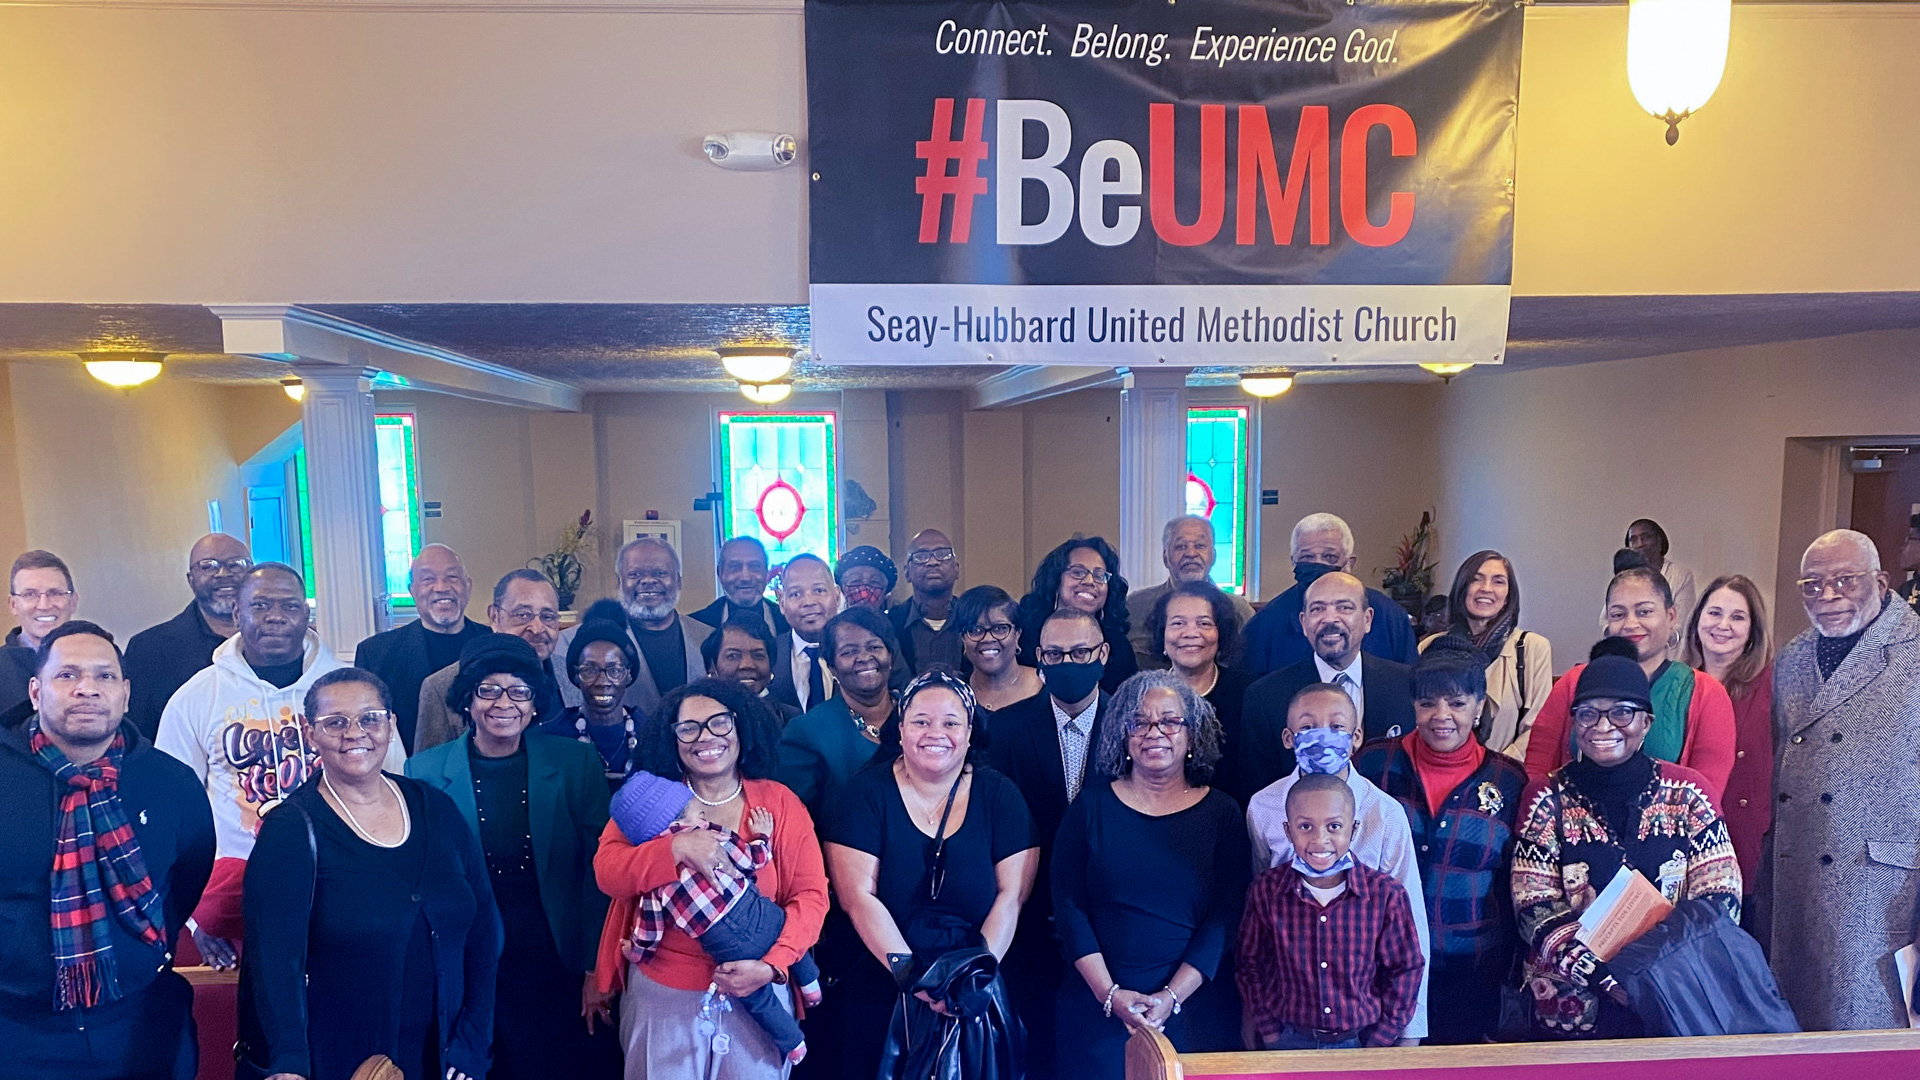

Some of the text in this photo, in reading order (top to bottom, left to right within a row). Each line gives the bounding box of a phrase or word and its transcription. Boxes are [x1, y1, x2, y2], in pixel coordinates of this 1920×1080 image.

[935, 19, 1399, 68] Connect. Belong. Experience God.
[915, 97, 1418, 247] #BeUMC
[867, 305, 1457, 348] Seay-Hubbard United Methodist Church
